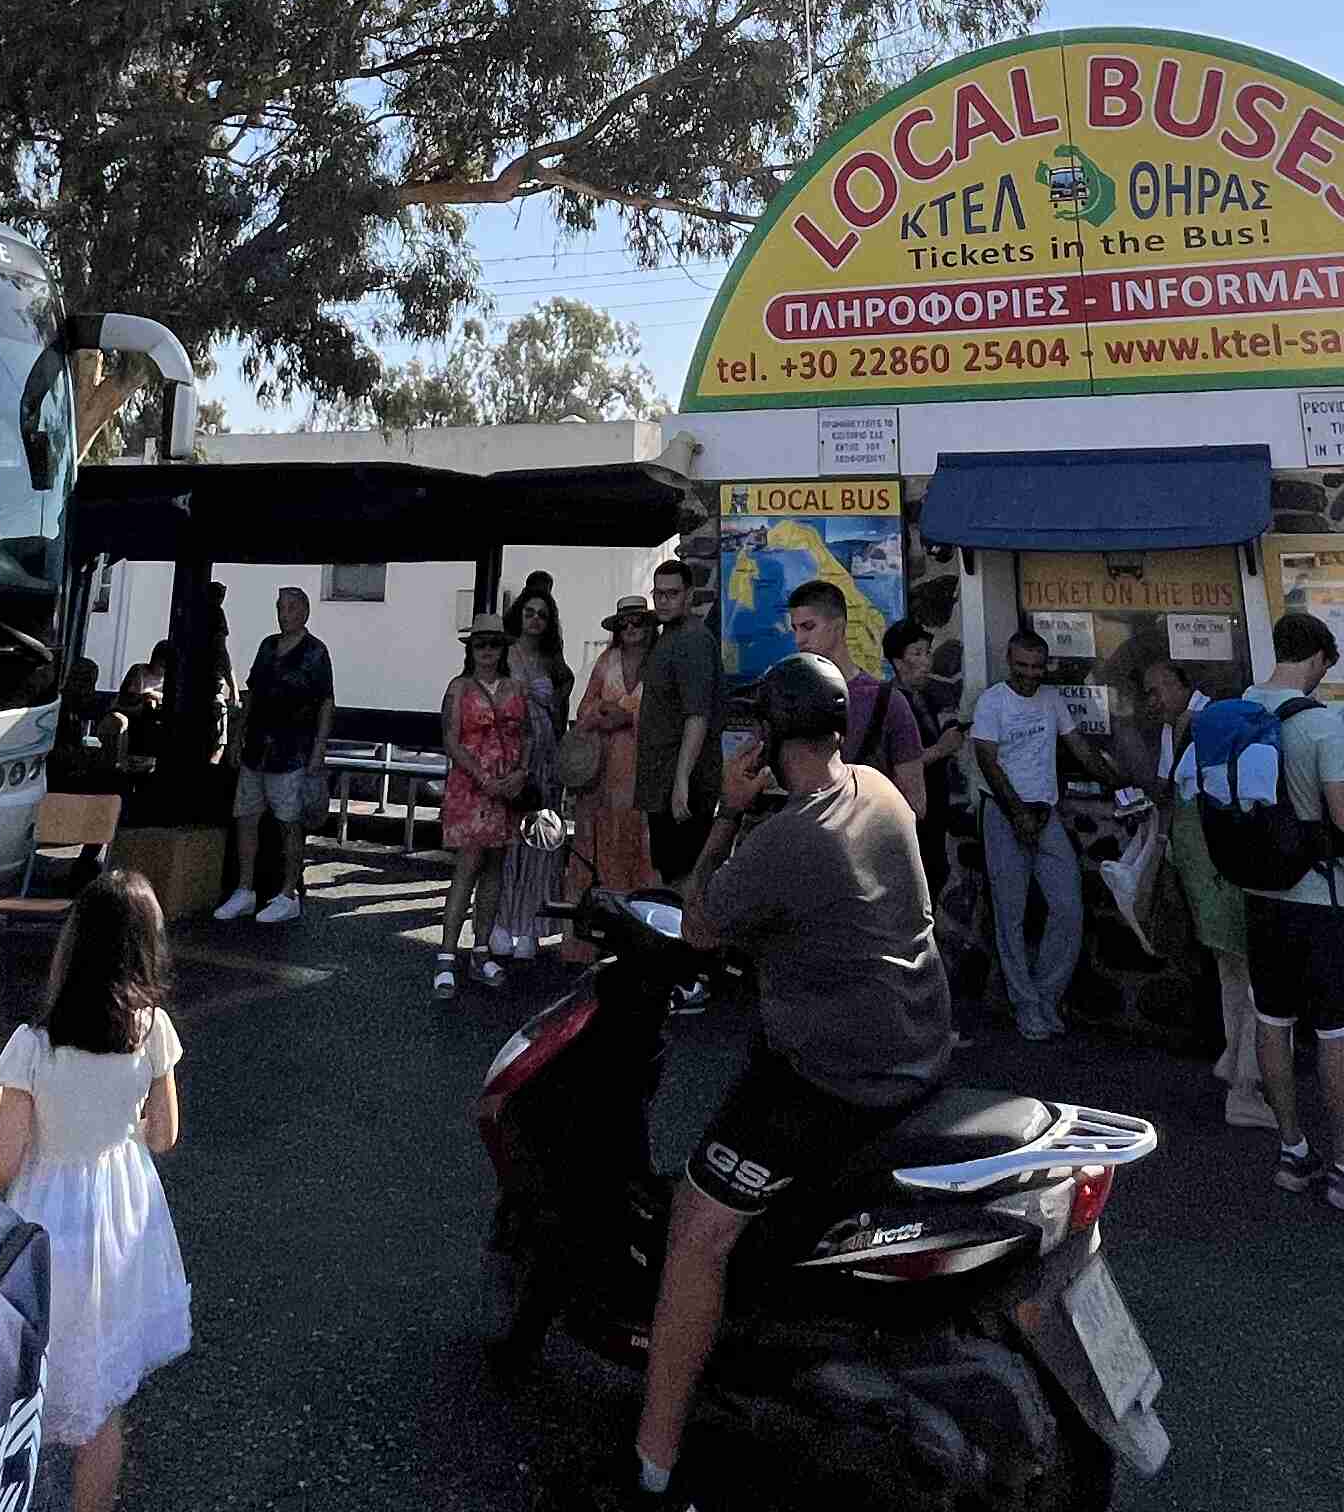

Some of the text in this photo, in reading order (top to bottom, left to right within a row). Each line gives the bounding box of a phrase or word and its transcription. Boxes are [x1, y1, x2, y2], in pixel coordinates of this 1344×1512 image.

[793, 67, 1060, 271] LOCAL
[900, 161, 1273, 241] ΚΤΕΛ ΘΗΡΑΣ
[907, 220, 1271, 270] Tickets in the Bus!
[784, 285, 1069, 332] ΠΛΗΡΟΦΟΡΙΕΣ
[716, 353, 768, 383] tel.
[781, 350, 837, 380] +30
[850, 344, 950, 377] 22860
[963, 338, 1069, 372] 25404
[1315, 444, 1327, 456] IN
[757, 488, 890, 511] LOCAL BUS
[1024, 580, 1233, 607] TICKET ON THE BUS
